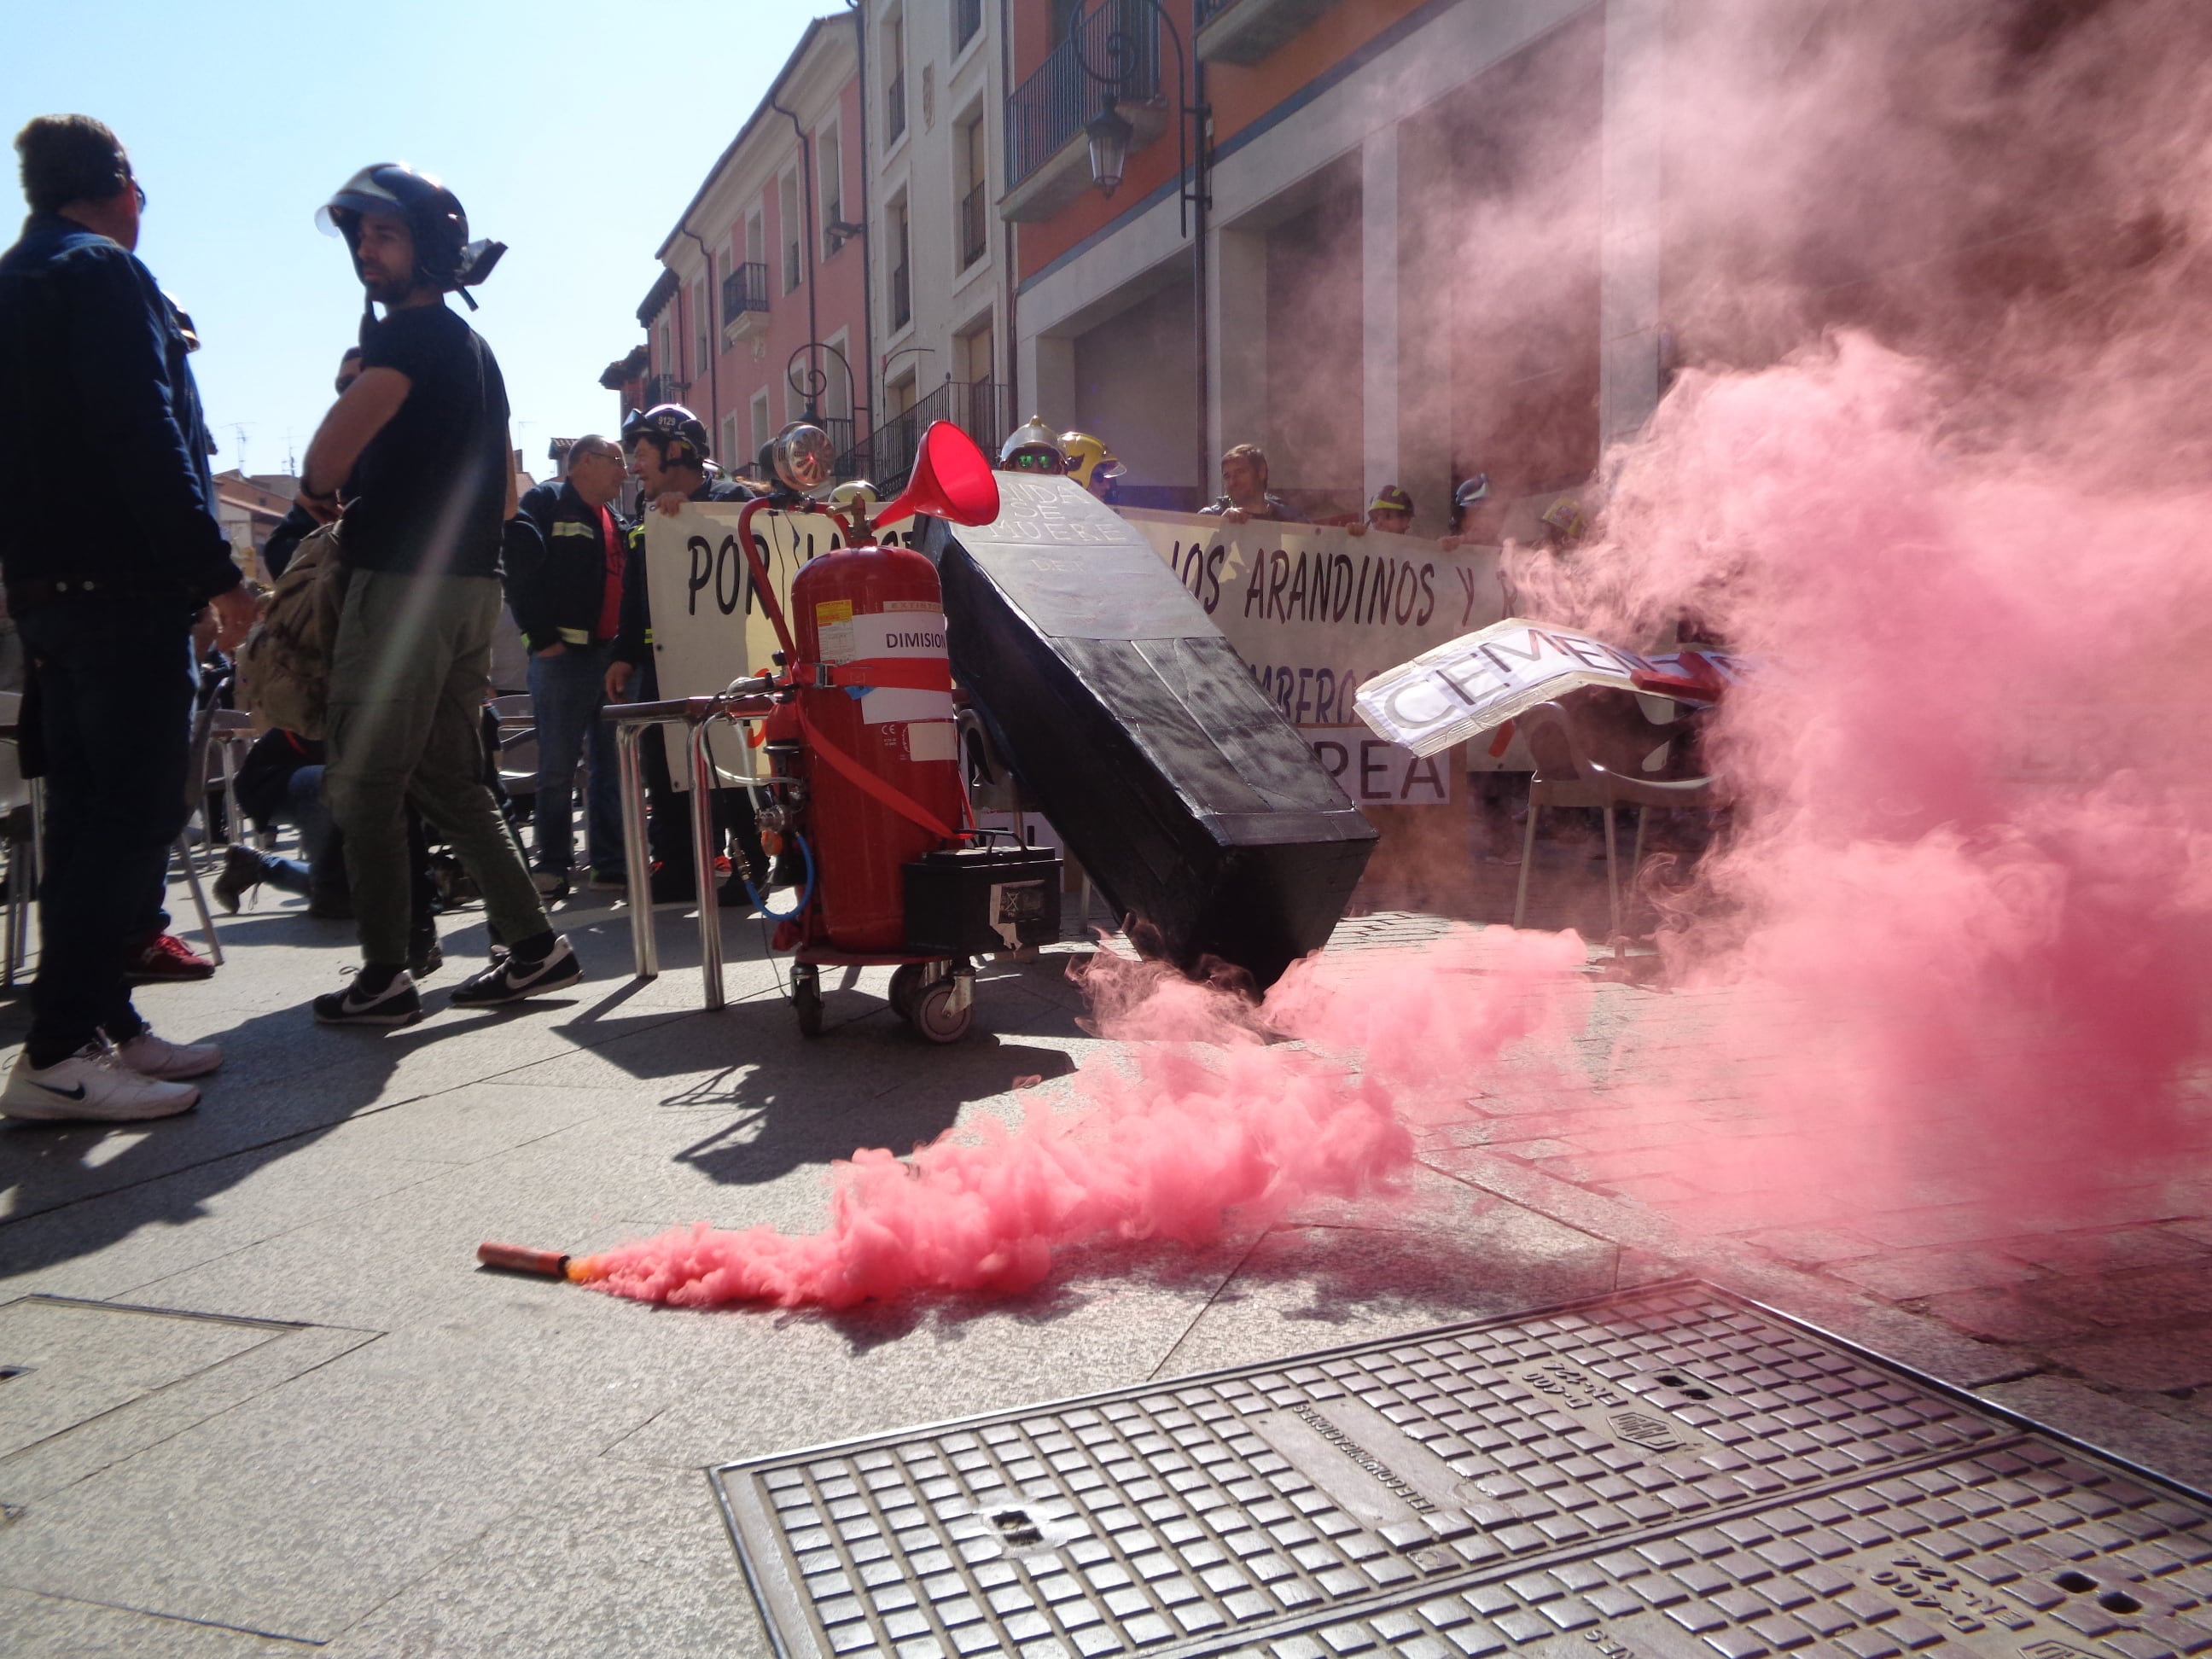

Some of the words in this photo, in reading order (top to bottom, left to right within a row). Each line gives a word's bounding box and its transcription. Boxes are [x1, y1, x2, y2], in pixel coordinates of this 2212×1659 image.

[1010, 501, 1065, 520] SE
[987, 520, 1126, 542] MUERE
[687, 534, 771, 620] POR
[1244, 548, 1435, 626] ARANDINOS
[1455, 567, 1475, 626] Y
[886, 632, 946, 649] DIMISION
[882, 725, 895, 735] CE
[1871, 1571, 1987, 1633] D-400
